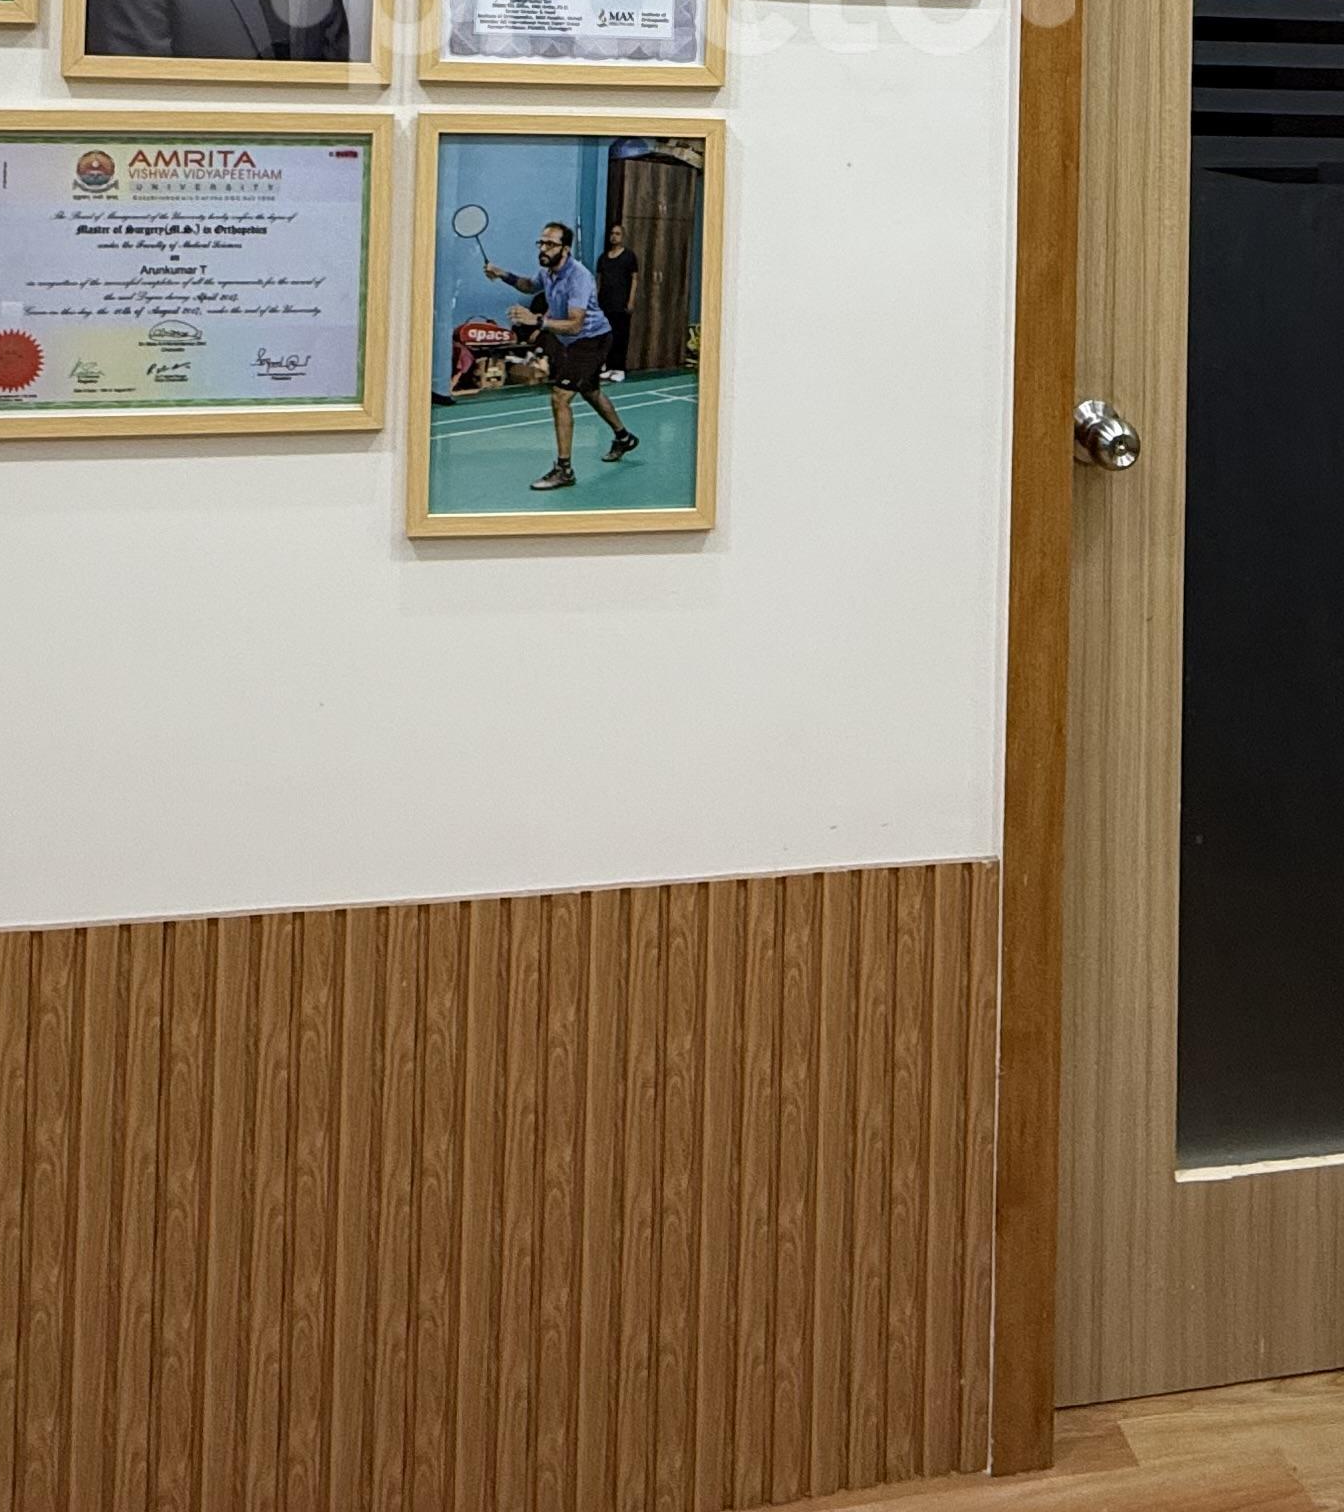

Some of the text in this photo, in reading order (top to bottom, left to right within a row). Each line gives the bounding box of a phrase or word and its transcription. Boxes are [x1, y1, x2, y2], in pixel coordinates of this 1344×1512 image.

[609, 11, 635, 22] MAX
[128, 149, 256, 168] AMRITA
[129, 169, 283, 180] VISHWA VIDYAPEETHAM
[140, 265, 207, 275] Arunkumar T
[468, 328, 511, 342] apacs
